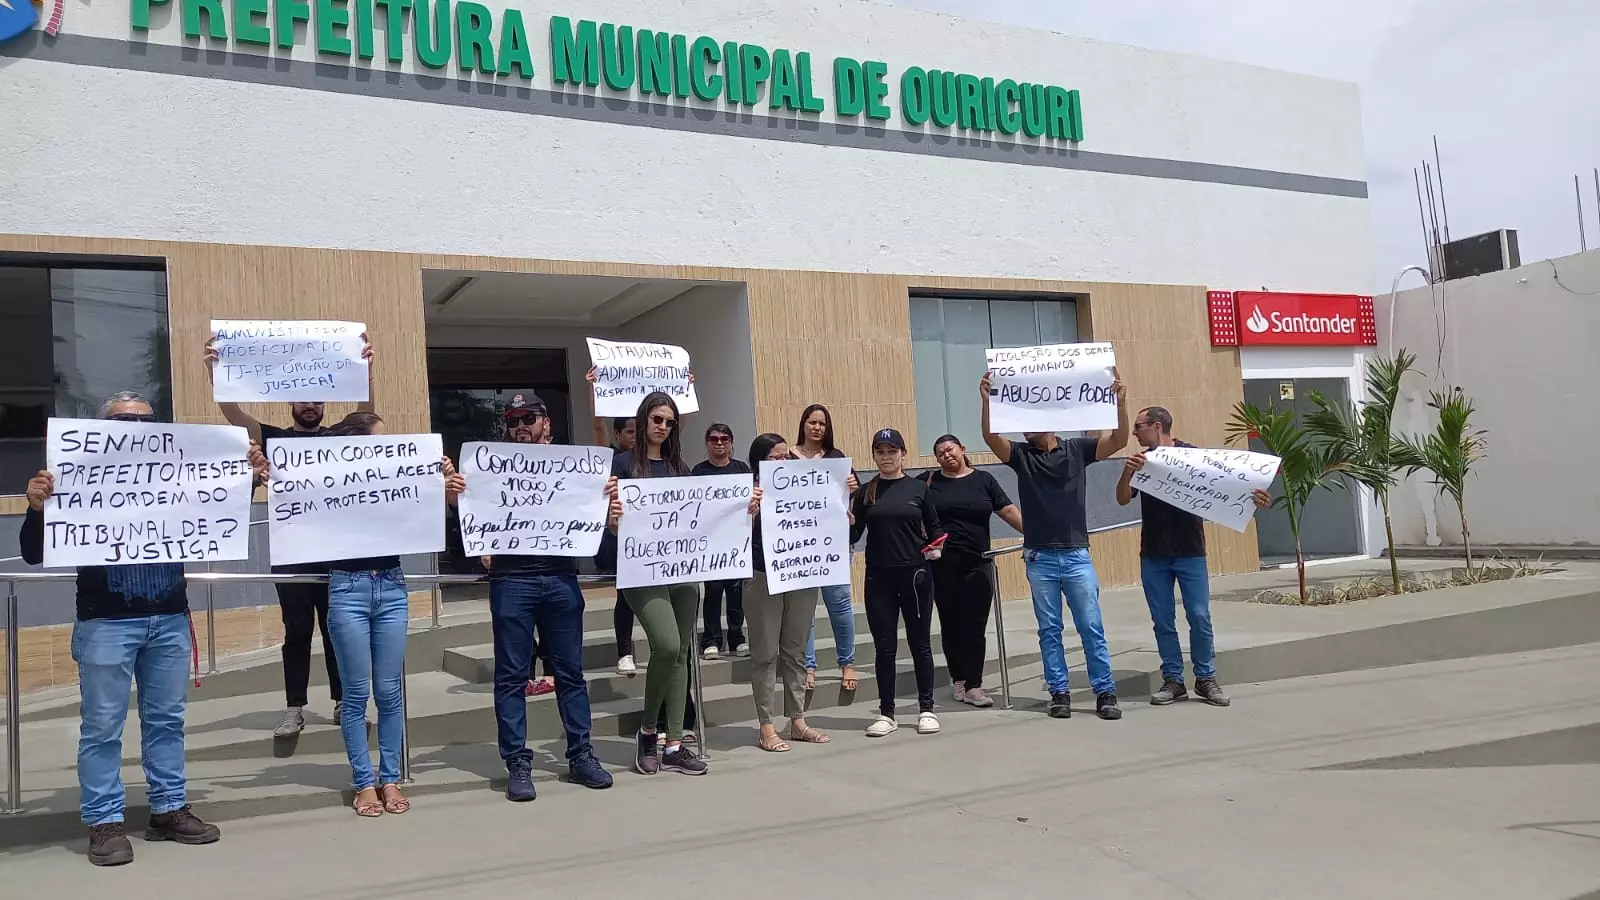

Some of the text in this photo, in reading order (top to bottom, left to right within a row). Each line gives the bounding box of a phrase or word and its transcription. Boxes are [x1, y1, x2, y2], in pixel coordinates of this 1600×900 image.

[549, 15, 824, 114] MUNICIPAL
[834, 57, 890, 120] DE
[903, 66, 1083, 142] OURICURI
[1271, 312, 1356, 333] Santander
[323, 341, 342, 352] DO
[593, 343, 672, 360] DITADURA
[1058, 349, 1080, 357] DOS
[224, 358, 352, 382] TJ-PE ÓRGÃO DA
[990, 366, 1015, 379] TOS
[1001, 383, 1115, 405] ABUSO DE PODER
[61, 430, 184, 459] SENHOR,
[272, 442, 417, 471] QUEM COOPERA
[272, 479, 315, 494] COM
[324, 476, 335, 488] O
[343, 467, 389, 486] MAL
[502, 476, 565, 492] não é
[109, 490, 189, 509] ORDEM
[198, 487, 228, 504] DO
[275, 485, 420, 521] SEM PROTESTAR!
[622, 484, 685, 511] RETORNO
[46, 518, 209, 549] TRIBUNAL DE
[462, 512, 535, 538] Respeitem
[104, 539, 219, 562] JUSTIÇA
[490, 538, 500, 550] e
[625, 536, 708, 559] QUEREMOS
[773, 536, 832, 554] QUERO O
[643, 537, 750, 580] TRABALHAR!
[771, 554, 840, 572] RETORNO AO
